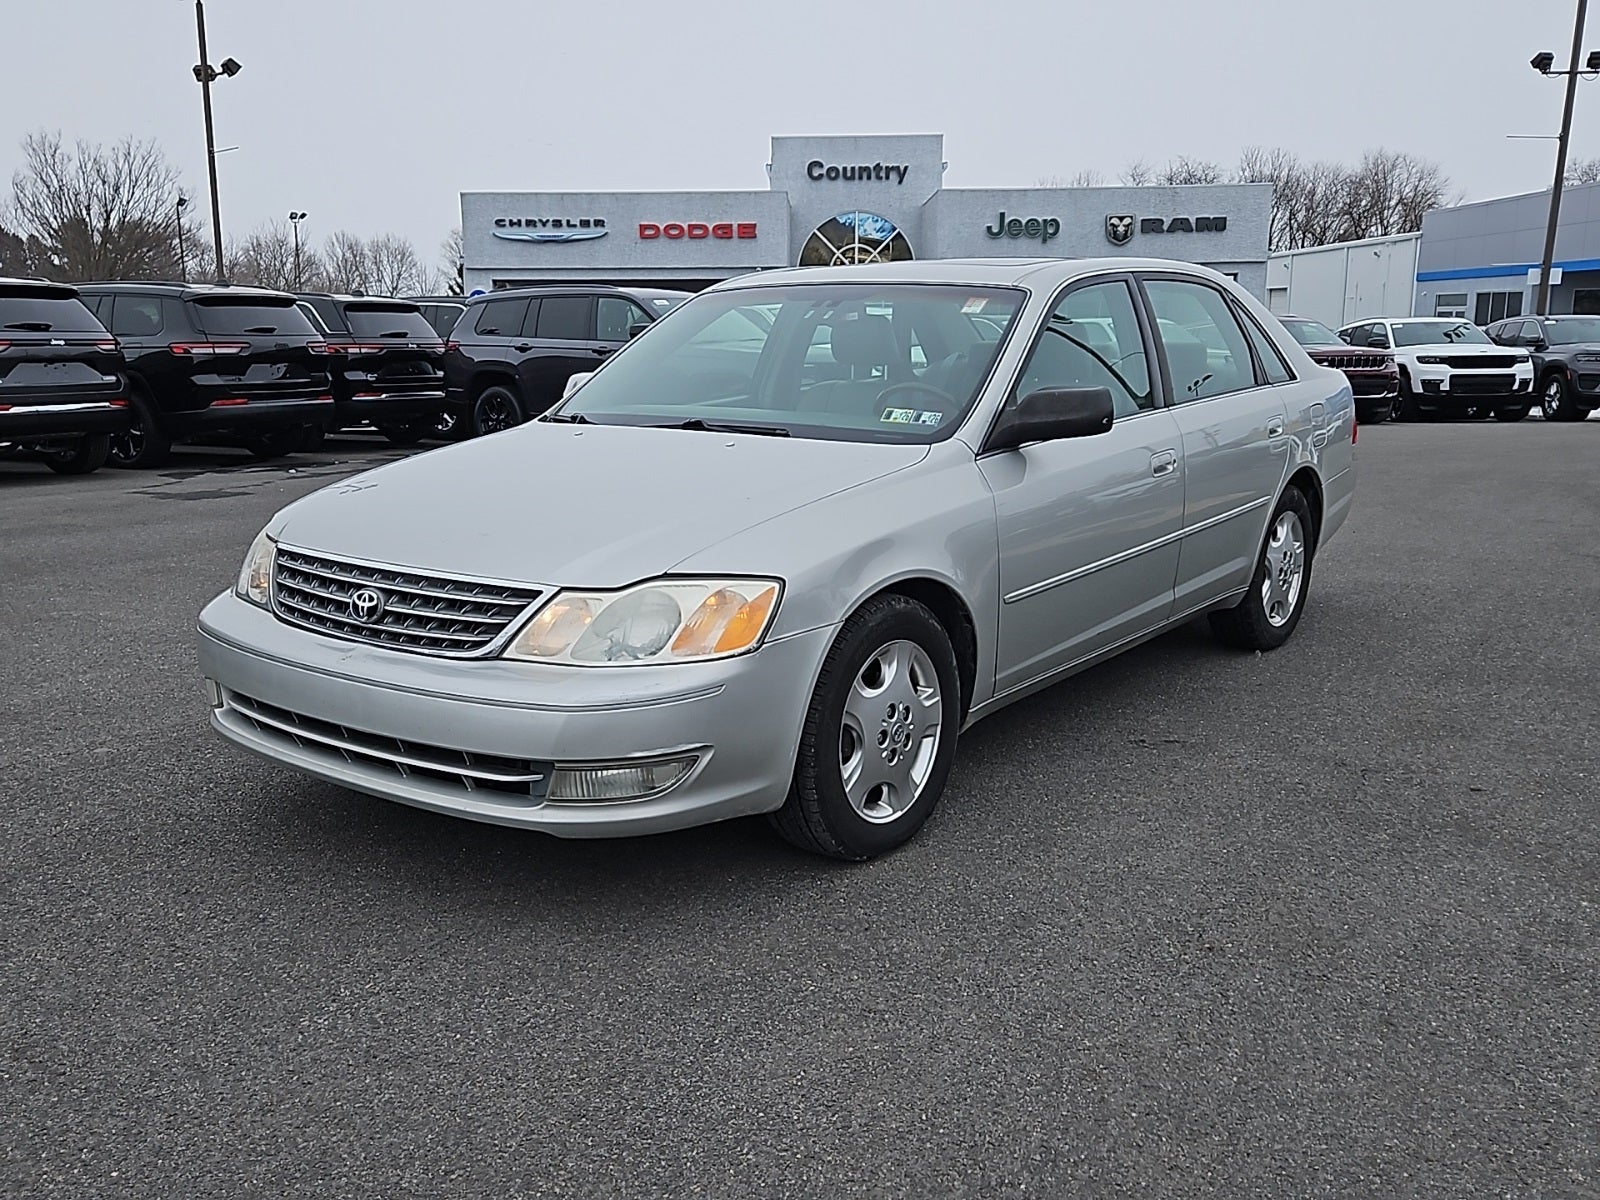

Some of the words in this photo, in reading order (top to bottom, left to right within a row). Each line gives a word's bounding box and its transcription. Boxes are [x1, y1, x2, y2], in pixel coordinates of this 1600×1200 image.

[806, 160, 909, 185] Country
[494, 218, 606, 228] CHRYSLER
[639, 223, 757, 239] DODGE
[986, 211, 1061, 244] Jeep
[1140, 216, 1227, 233] RAM
